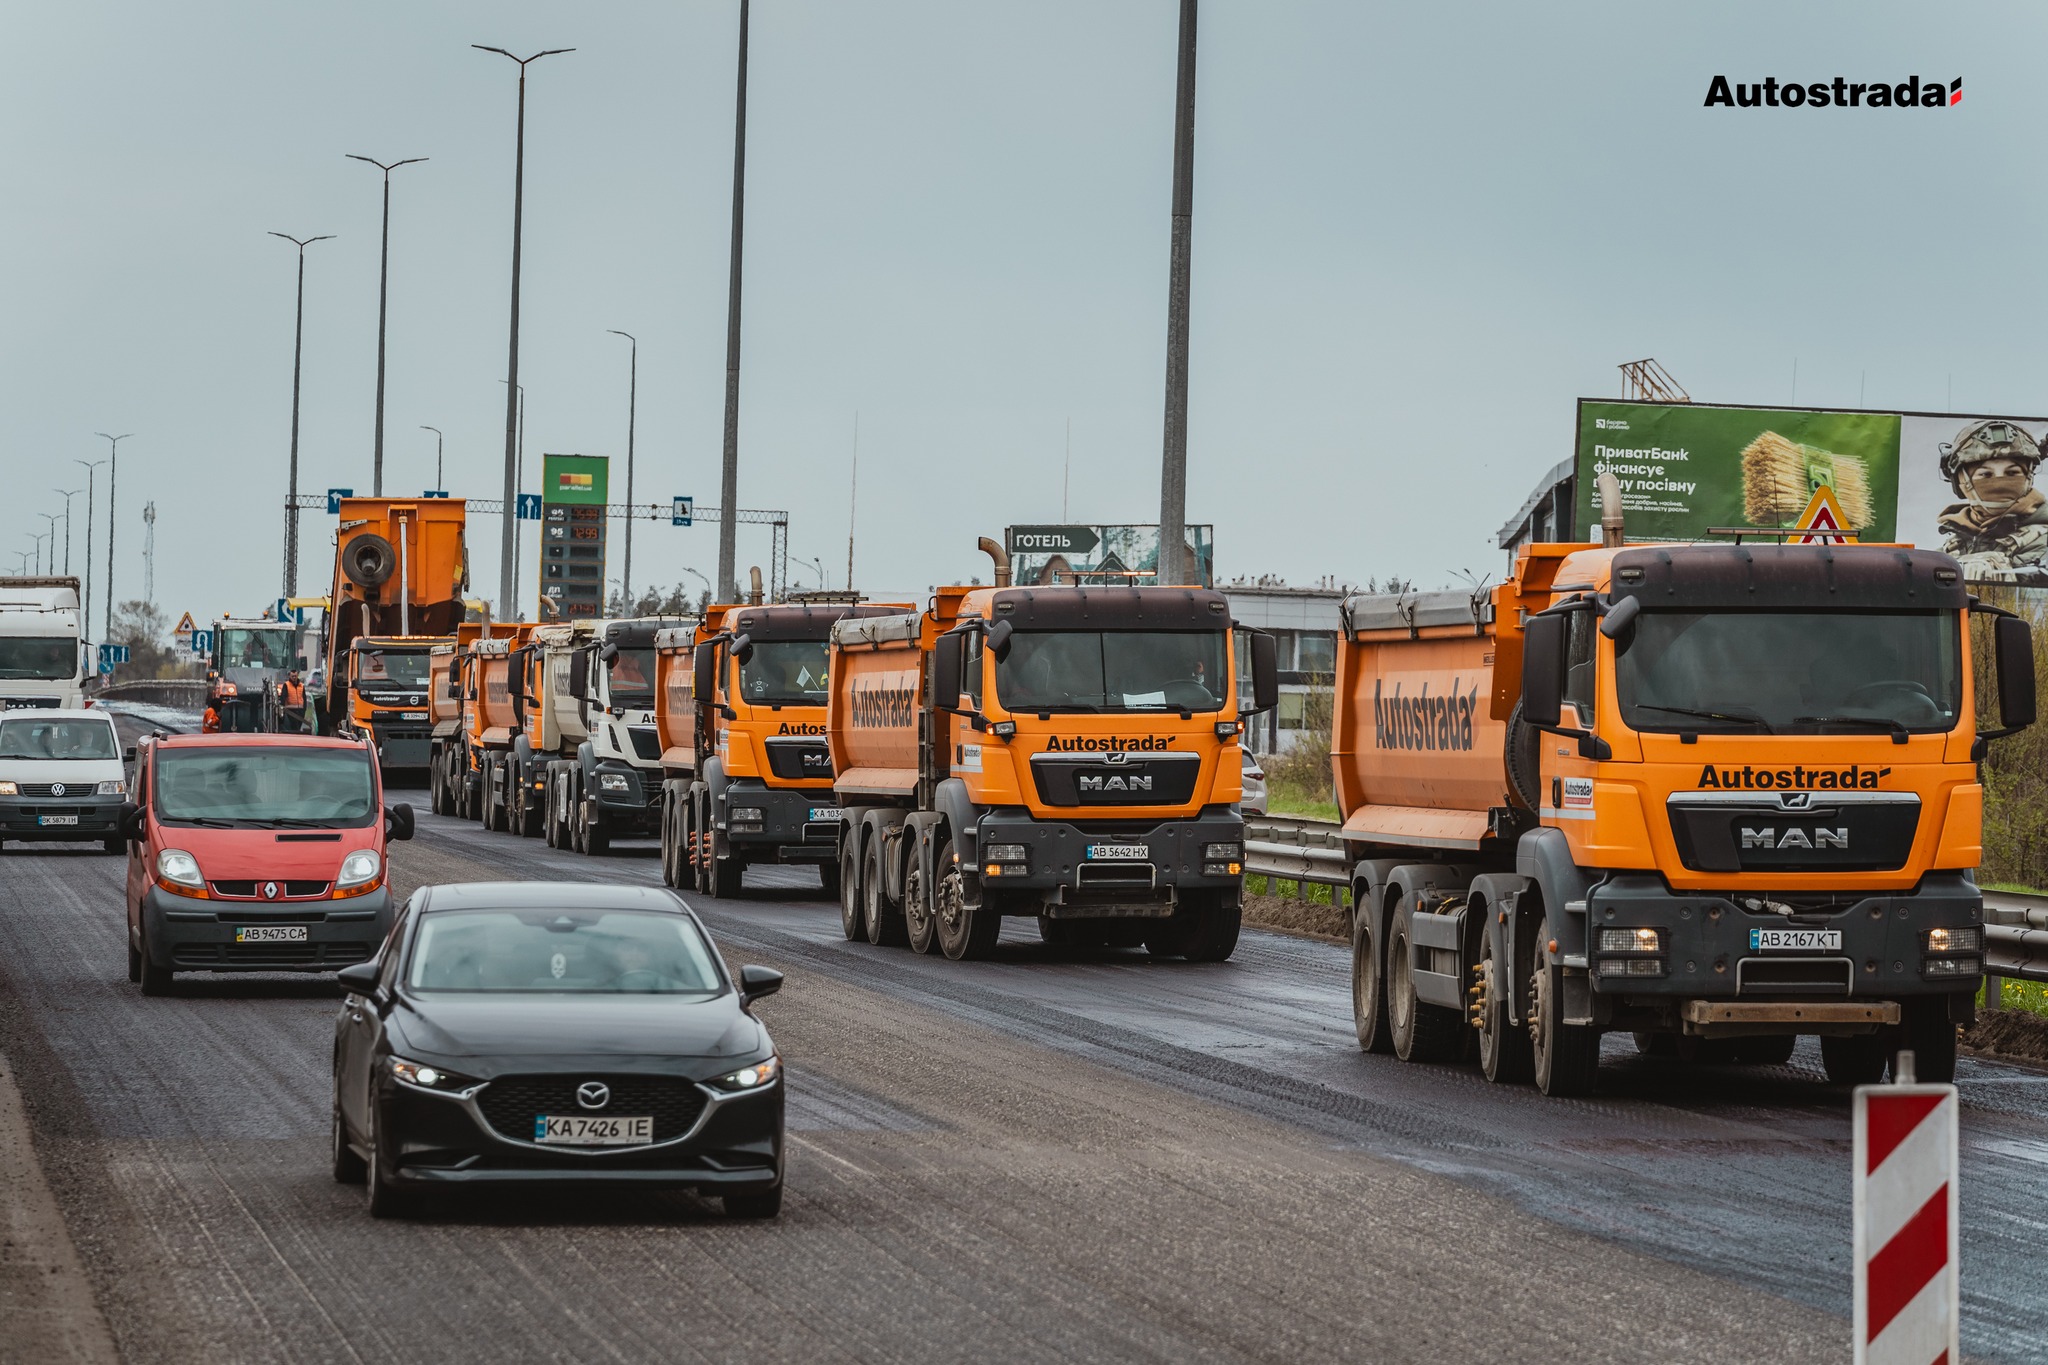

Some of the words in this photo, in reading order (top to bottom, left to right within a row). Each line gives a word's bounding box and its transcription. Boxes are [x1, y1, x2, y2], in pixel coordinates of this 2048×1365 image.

[1594, 445, 1689, 461] ПриватБанк
[1593, 461, 1665, 477] фінансує
[1636, 478, 1696, 495] посівну
[1016, 534, 1071, 548] ГОТЕЛЬ
[851, 675, 914, 729] Autostrada
[1374, 677, 1474, 751] Autostrada
[778, 722, 827, 735] Autos
[1046, 735, 1168, 751] Autostrada
[1080, 776, 1152, 790] MAN
[1697, 765, 1879, 788] Autostrada
[1741, 827, 1849, 849] MAN
[1093, 848, 1107, 857] AB
[1109, 848, 1131, 857] 5642
[1132, 848, 1147, 857] HX
[244, 929, 260, 939] AB
[262, 929, 287, 939] 9475
[289, 928, 305, 939] CA
[1760, 932, 1781, 946] AB
[1784, 932, 1815, 946] 2167
[1817, 932, 1838, 946] KT
[546, 1119, 573, 1136] KA
[577, 1120, 620, 1137] 7426
[628, 1119, 649, 1136] IE
